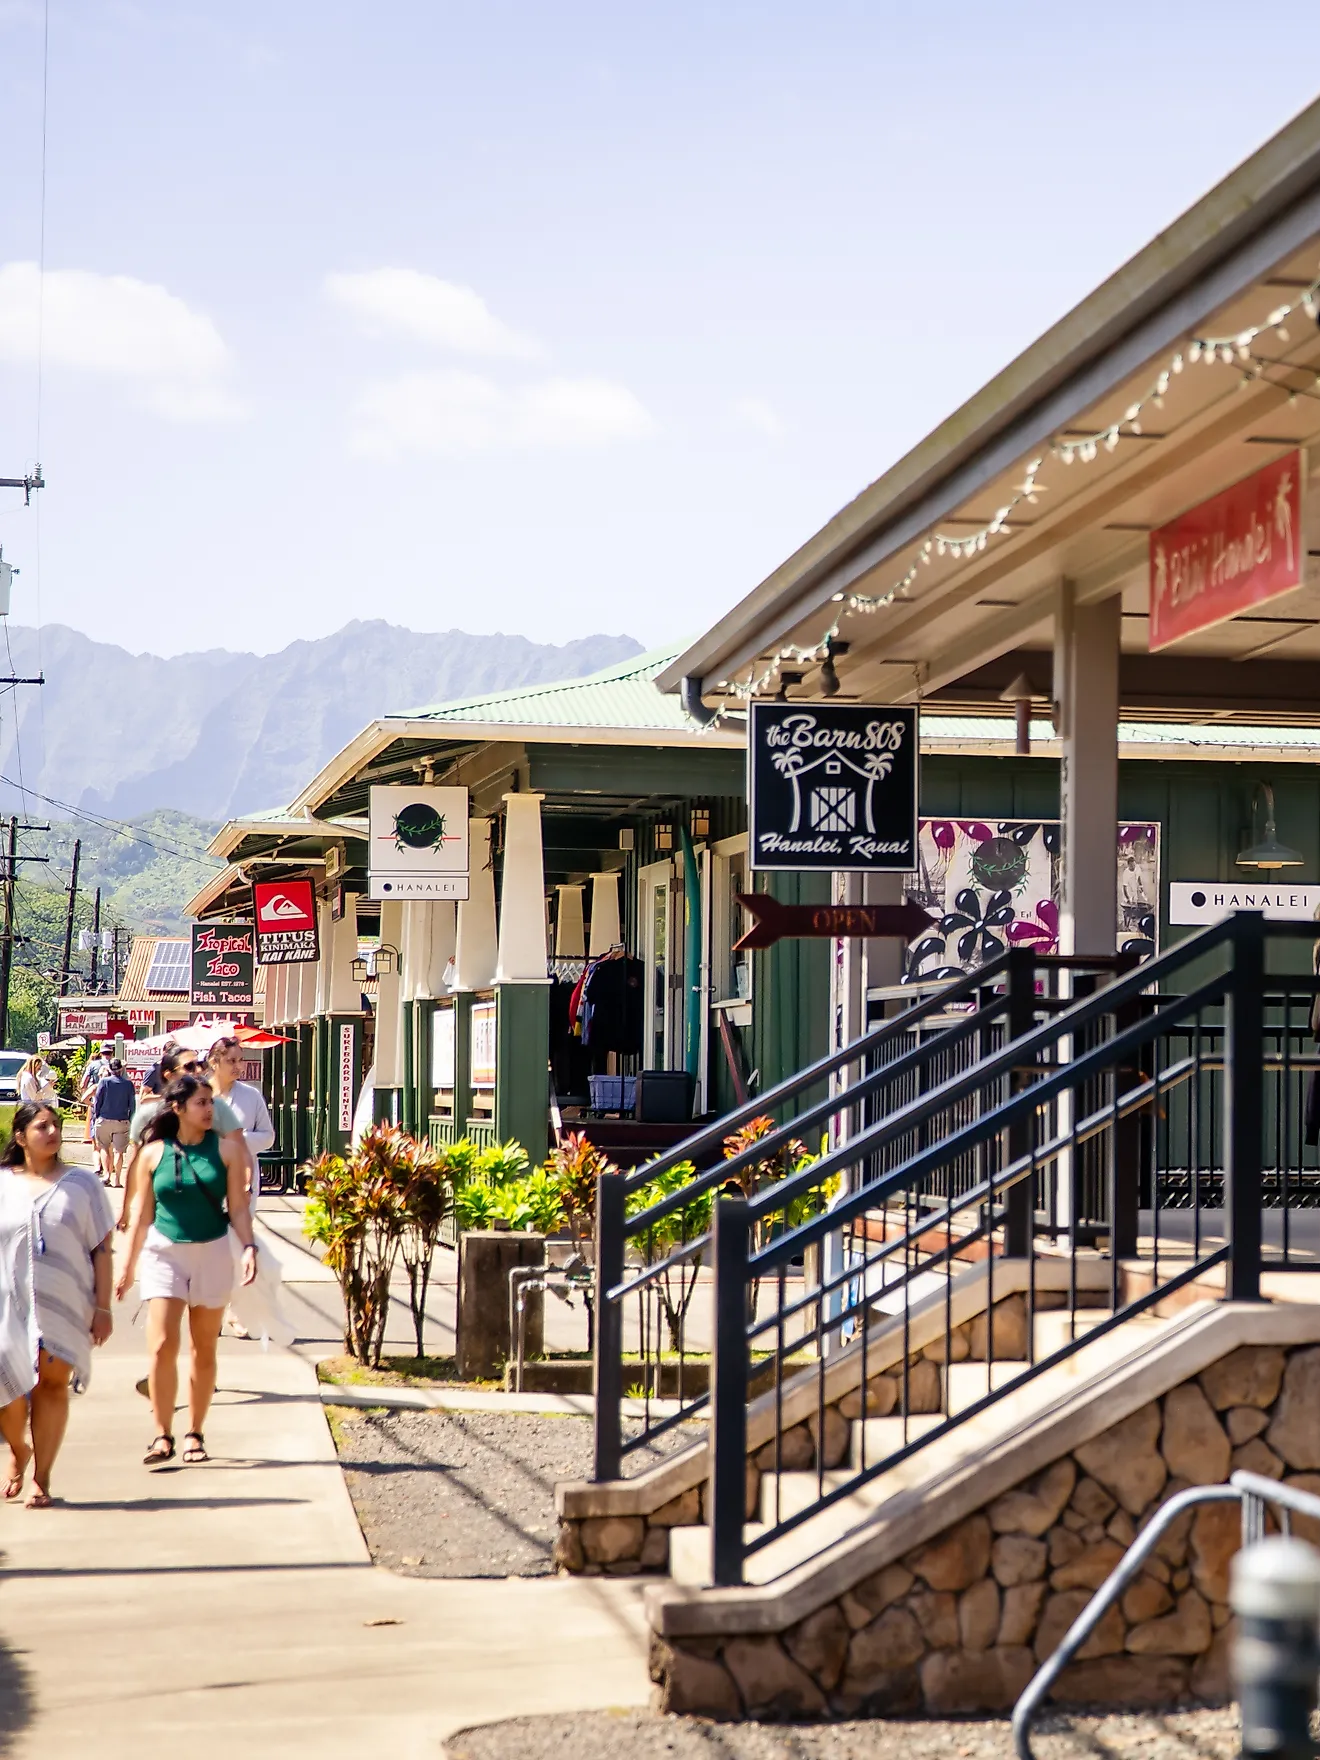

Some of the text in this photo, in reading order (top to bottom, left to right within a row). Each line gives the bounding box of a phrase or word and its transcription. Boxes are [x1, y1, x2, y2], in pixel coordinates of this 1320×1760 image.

[766, 724, 790, 747] the
[759, 832, 910, 859] Hanalei, Kauai
[397, 884, 455, 892] HANALEI
[1214, 894, 1308, 907] HANALEI
[812, 909, 876, 932] OPEN
[260, 930, 316, 944] TITUS
[260, 942, 316, 952] KINIMAKA
[261, 951, 283, 963] KAI
[206, 954, 240, 977] Taco
[193, 991, 252, 1003] Fish Tacos
[129, 1009, 154, 1021] ATM
[341, 1026, 351, 1129] SURFBOARD RENTALS
